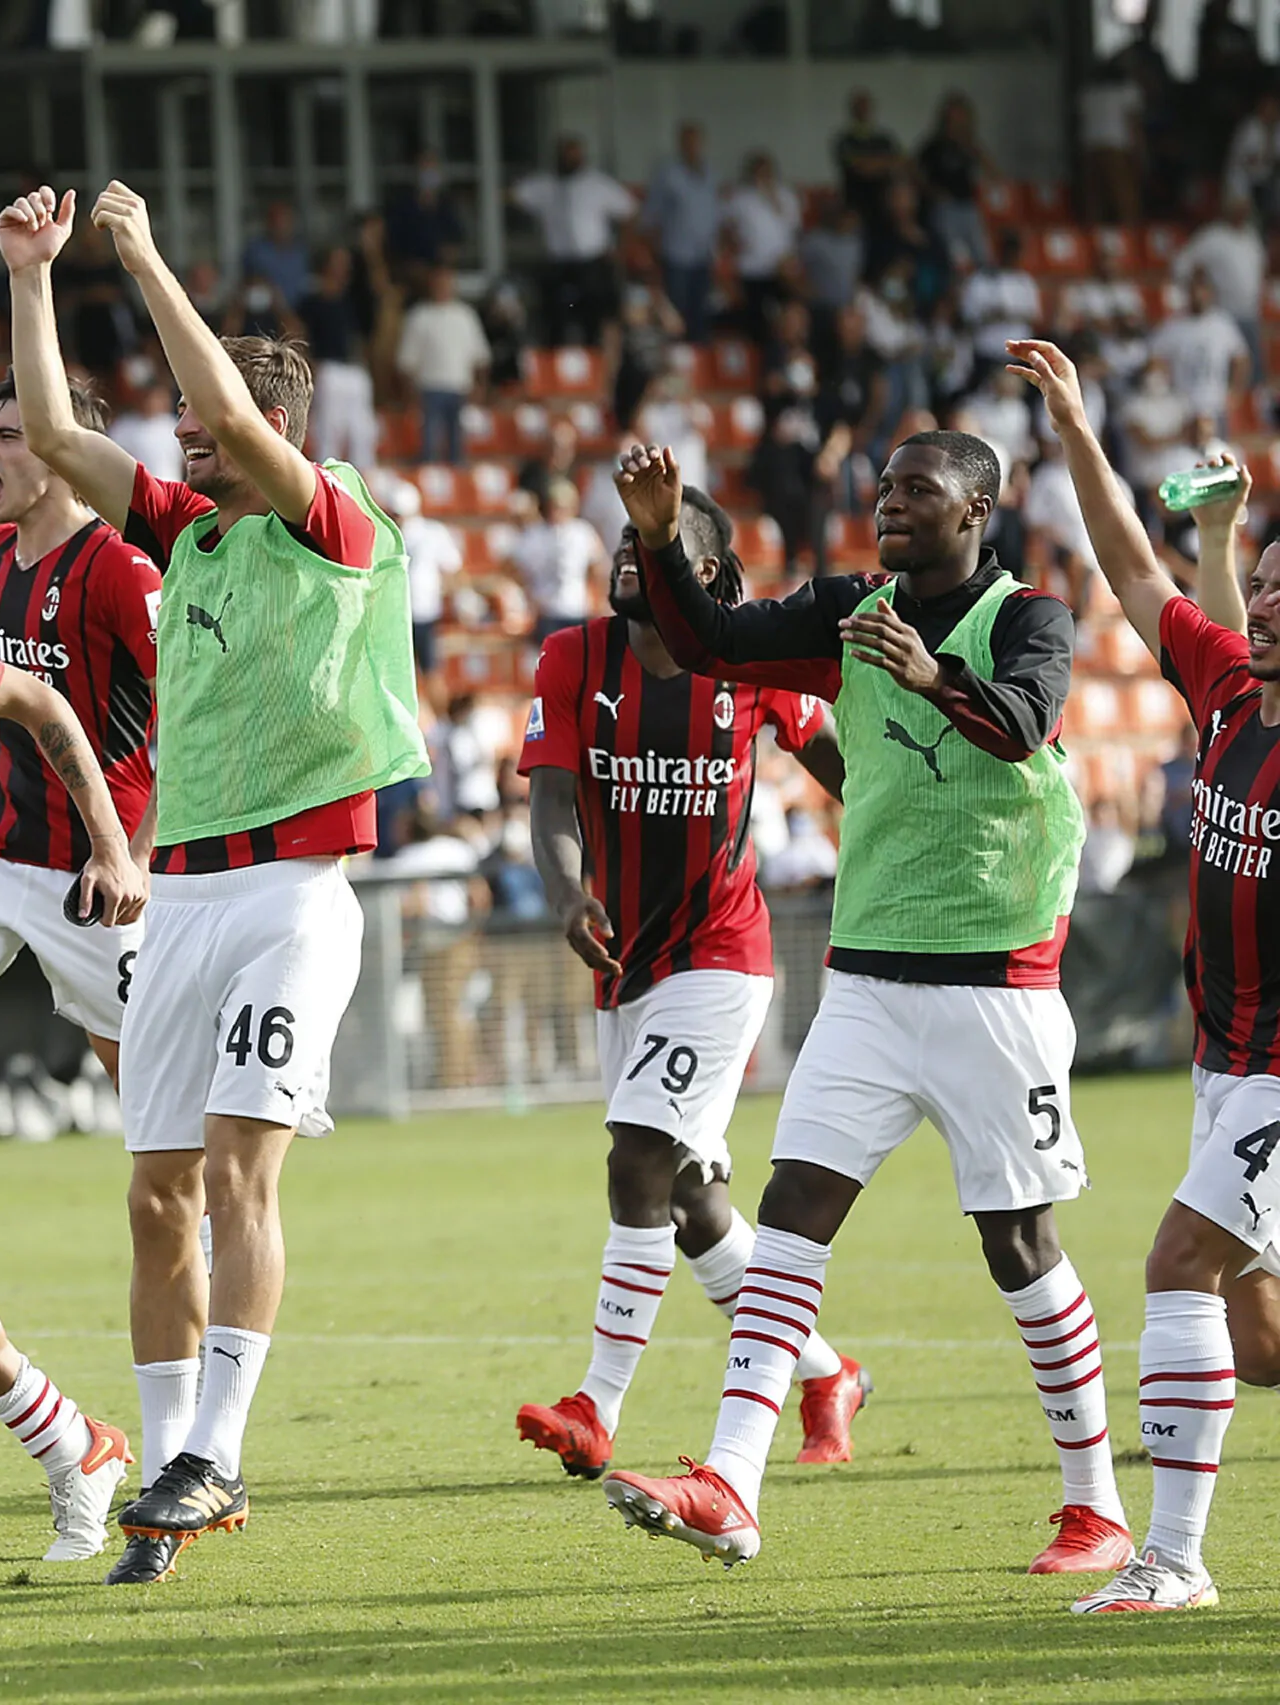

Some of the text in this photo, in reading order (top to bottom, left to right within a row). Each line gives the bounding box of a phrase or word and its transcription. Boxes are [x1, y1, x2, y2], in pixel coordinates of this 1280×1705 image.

[588, 747, 736, 785] Emirates
[610, 785, 717, 817] FLY BETTER
[1191, 779, 1280, 840] mirate
[1204, 832, 1272, 879] BETTER
[226, 1004, 295, 1068] 46
[626, 1034, 698, 1094] 79
[1028, 1084, 1061, 1151] 5
[1233, 1120, 1280, 1183] 4
